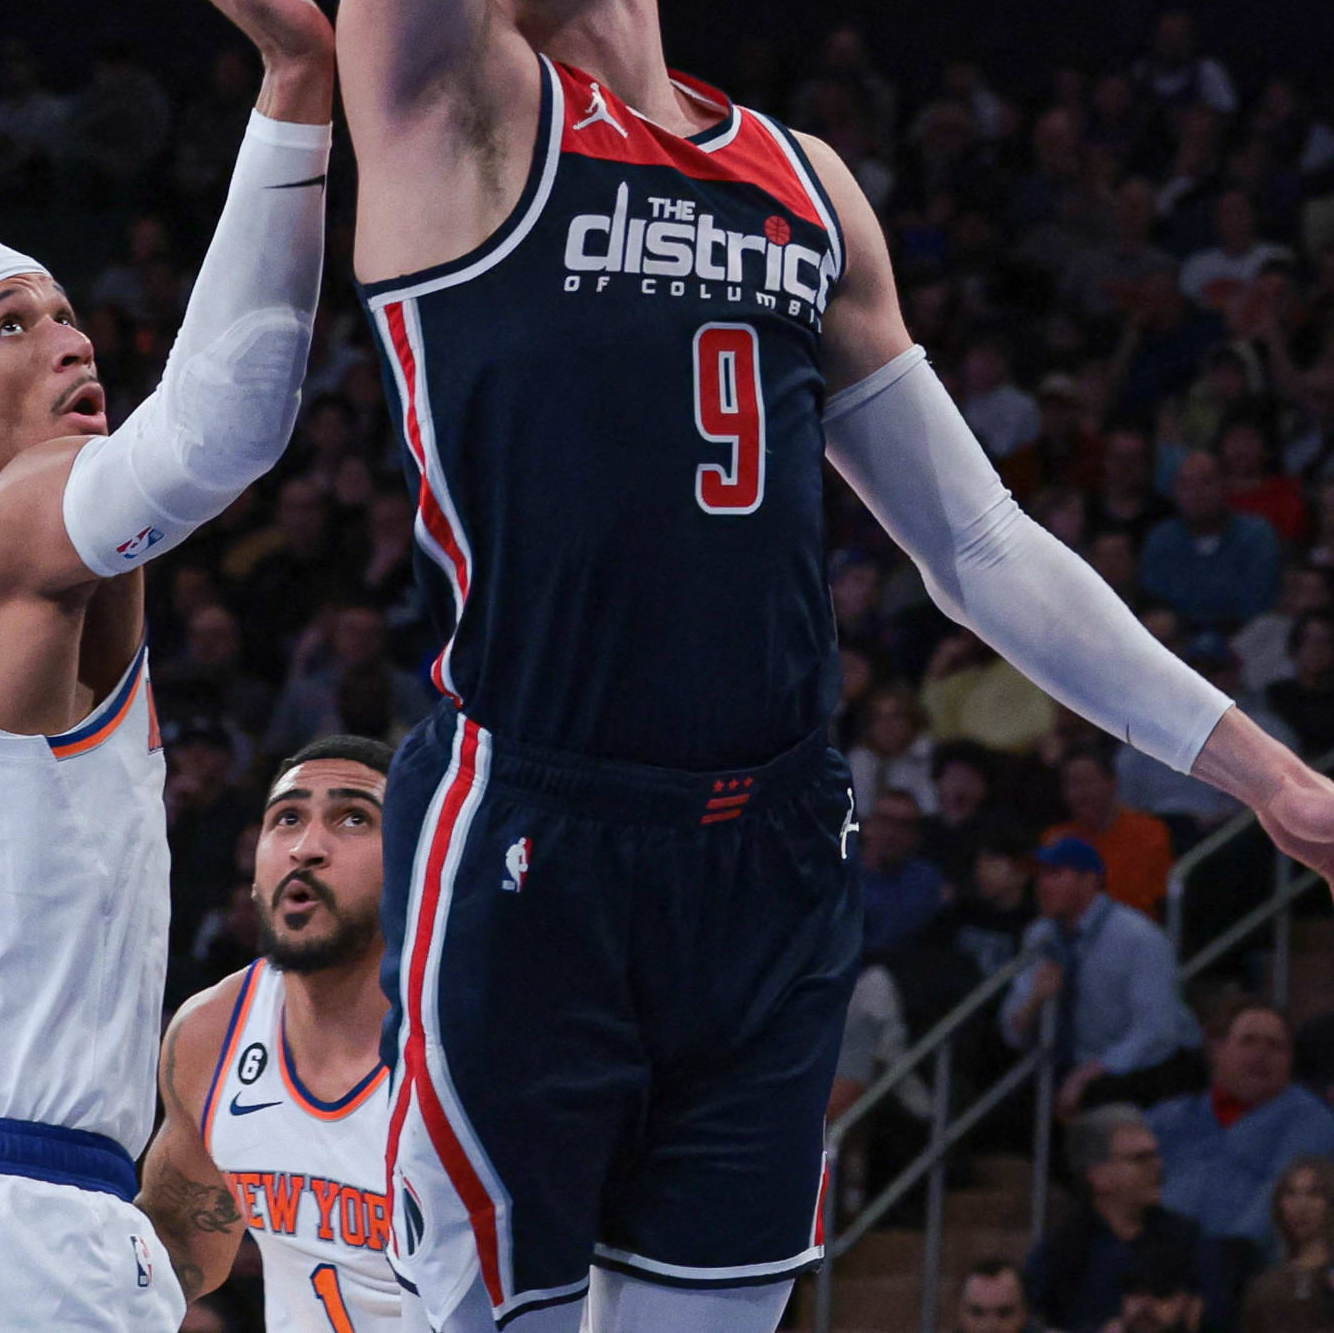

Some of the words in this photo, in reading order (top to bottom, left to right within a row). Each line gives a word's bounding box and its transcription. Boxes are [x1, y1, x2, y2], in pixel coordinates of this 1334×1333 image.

[647, 196, 696, 221] THE
[563, 275, 610, 293] OF
[692, 321, 767, 515] 9
[241, 1047, 264, 1082] 6
